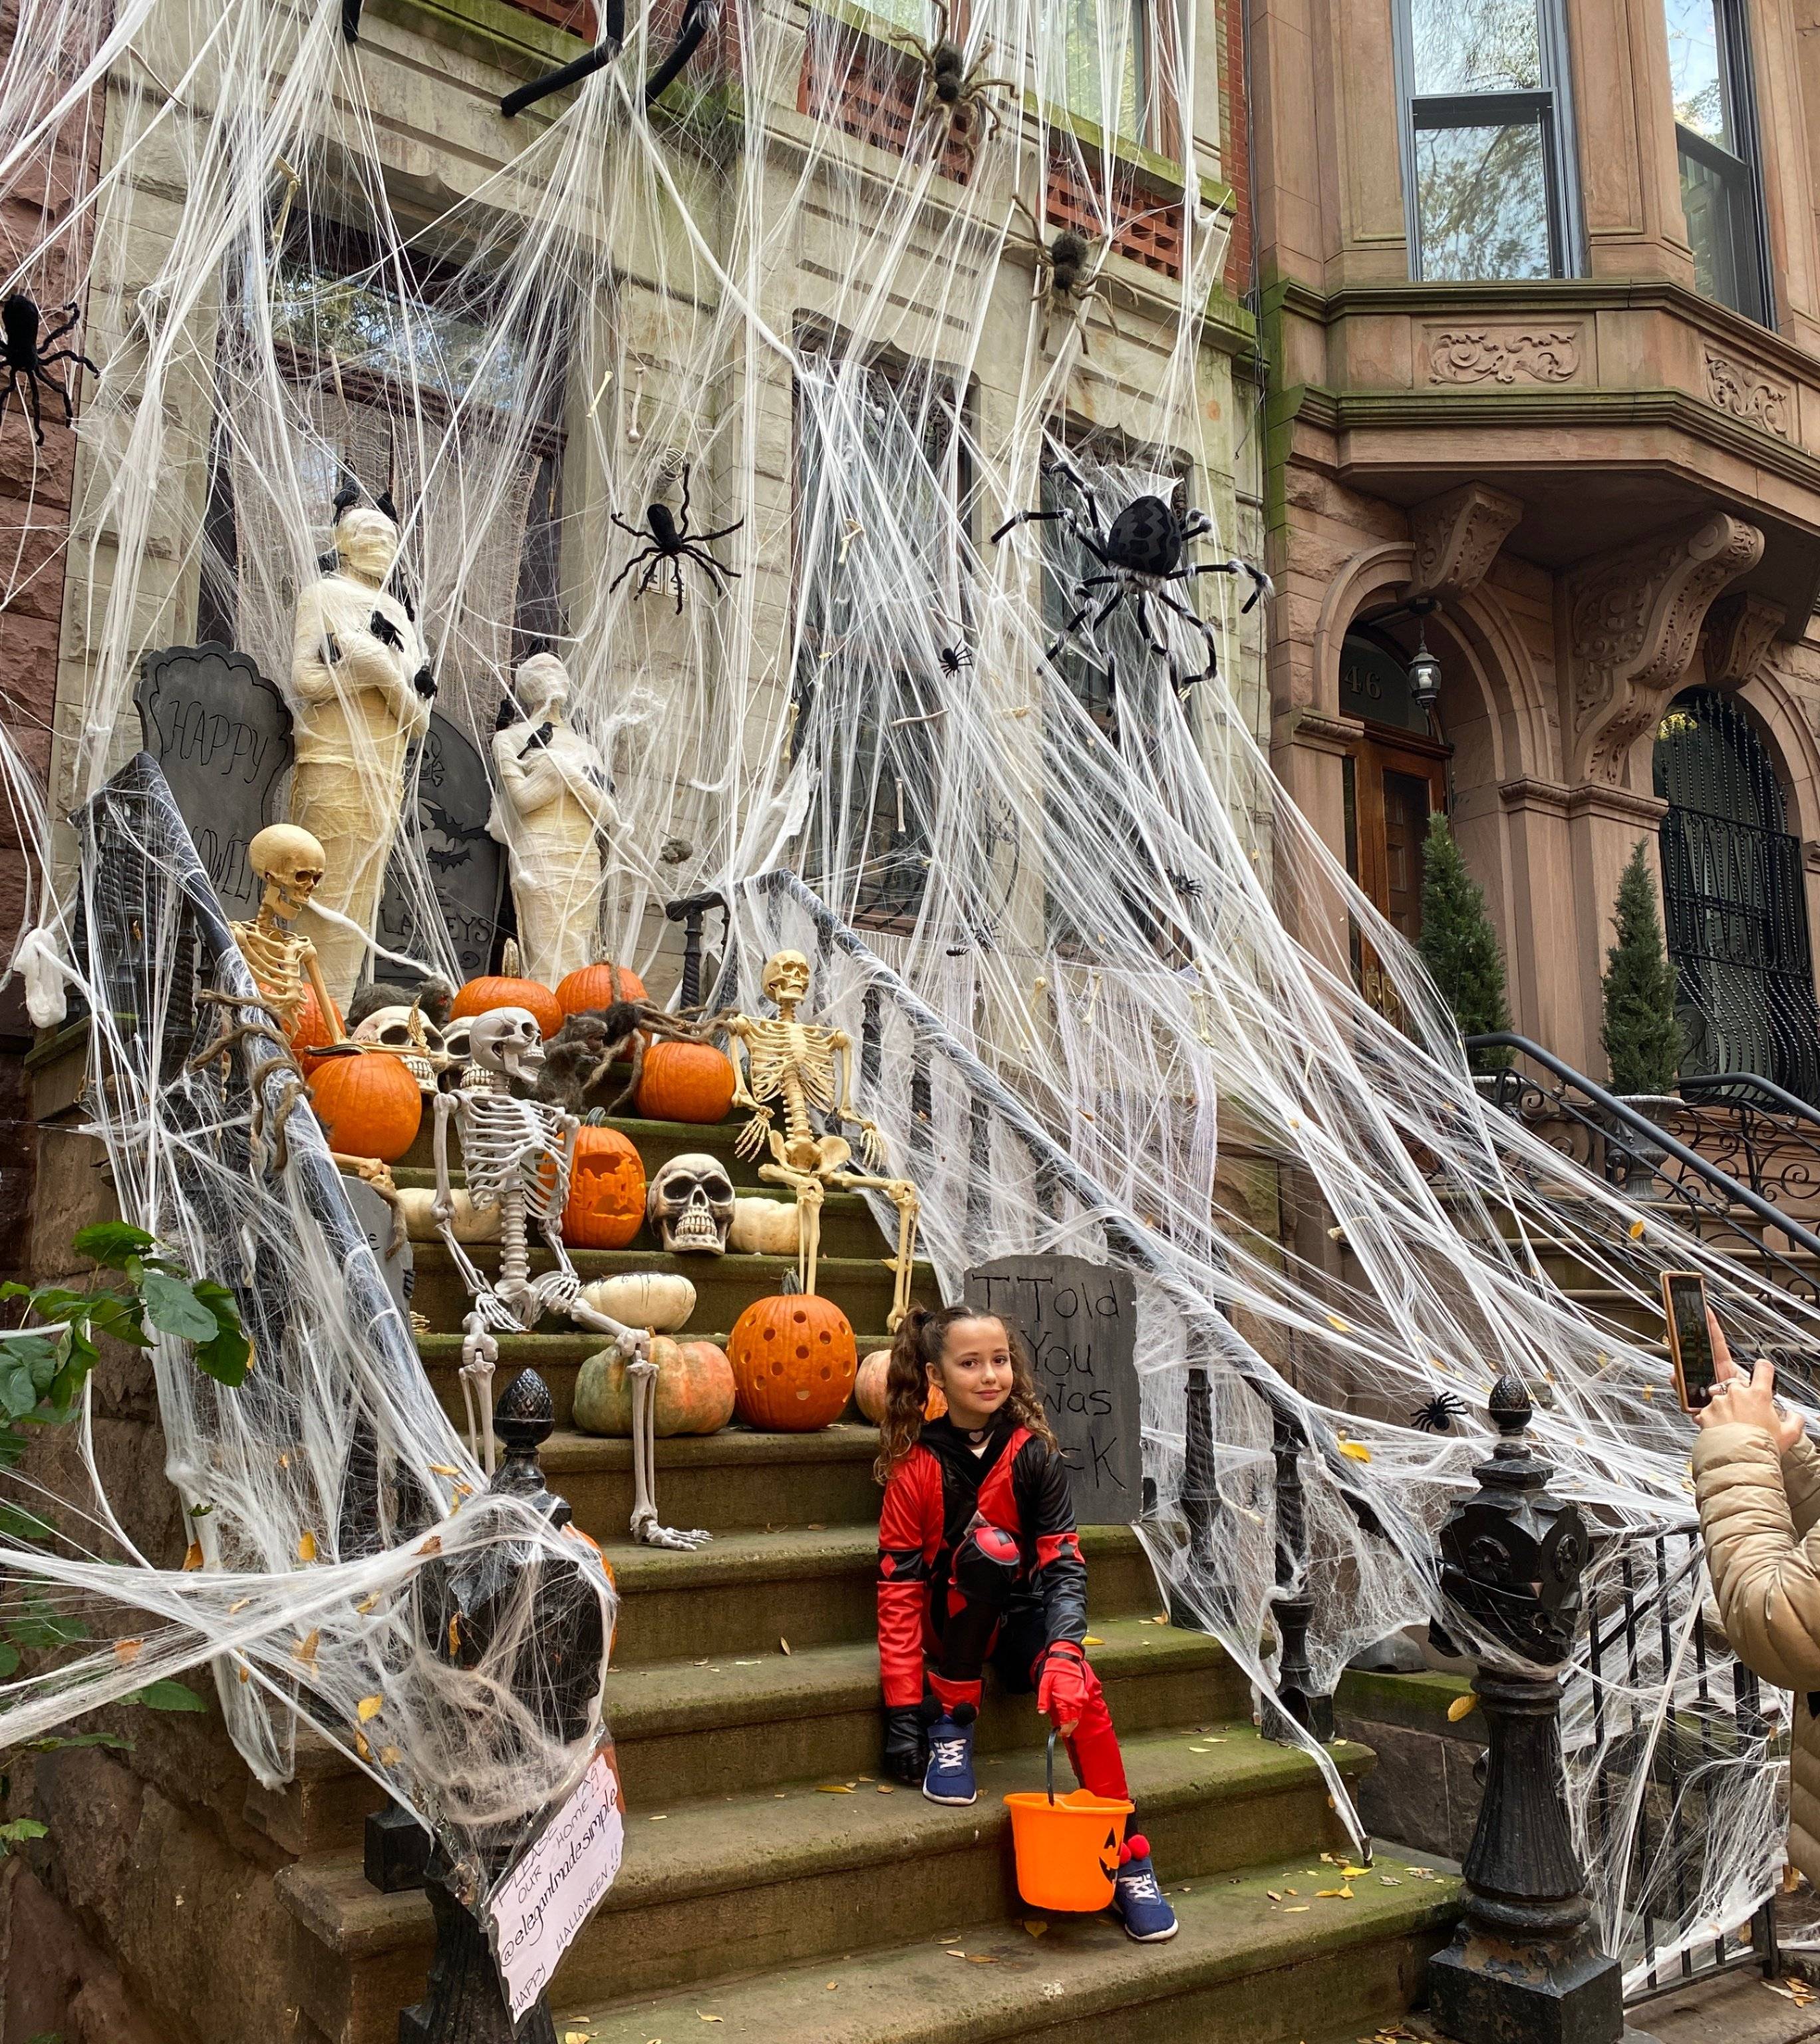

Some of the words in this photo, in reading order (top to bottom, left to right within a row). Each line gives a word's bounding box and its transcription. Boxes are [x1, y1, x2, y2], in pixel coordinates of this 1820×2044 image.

[1344, 665, 1382, 700] 46
[164, 700, 269, 784] HAPPY
[497, 1820, 558, 1908] PLEASE
[518, 1864, 542, 1904] OUR
[513, 1962, 546, 2014] HAPPY
